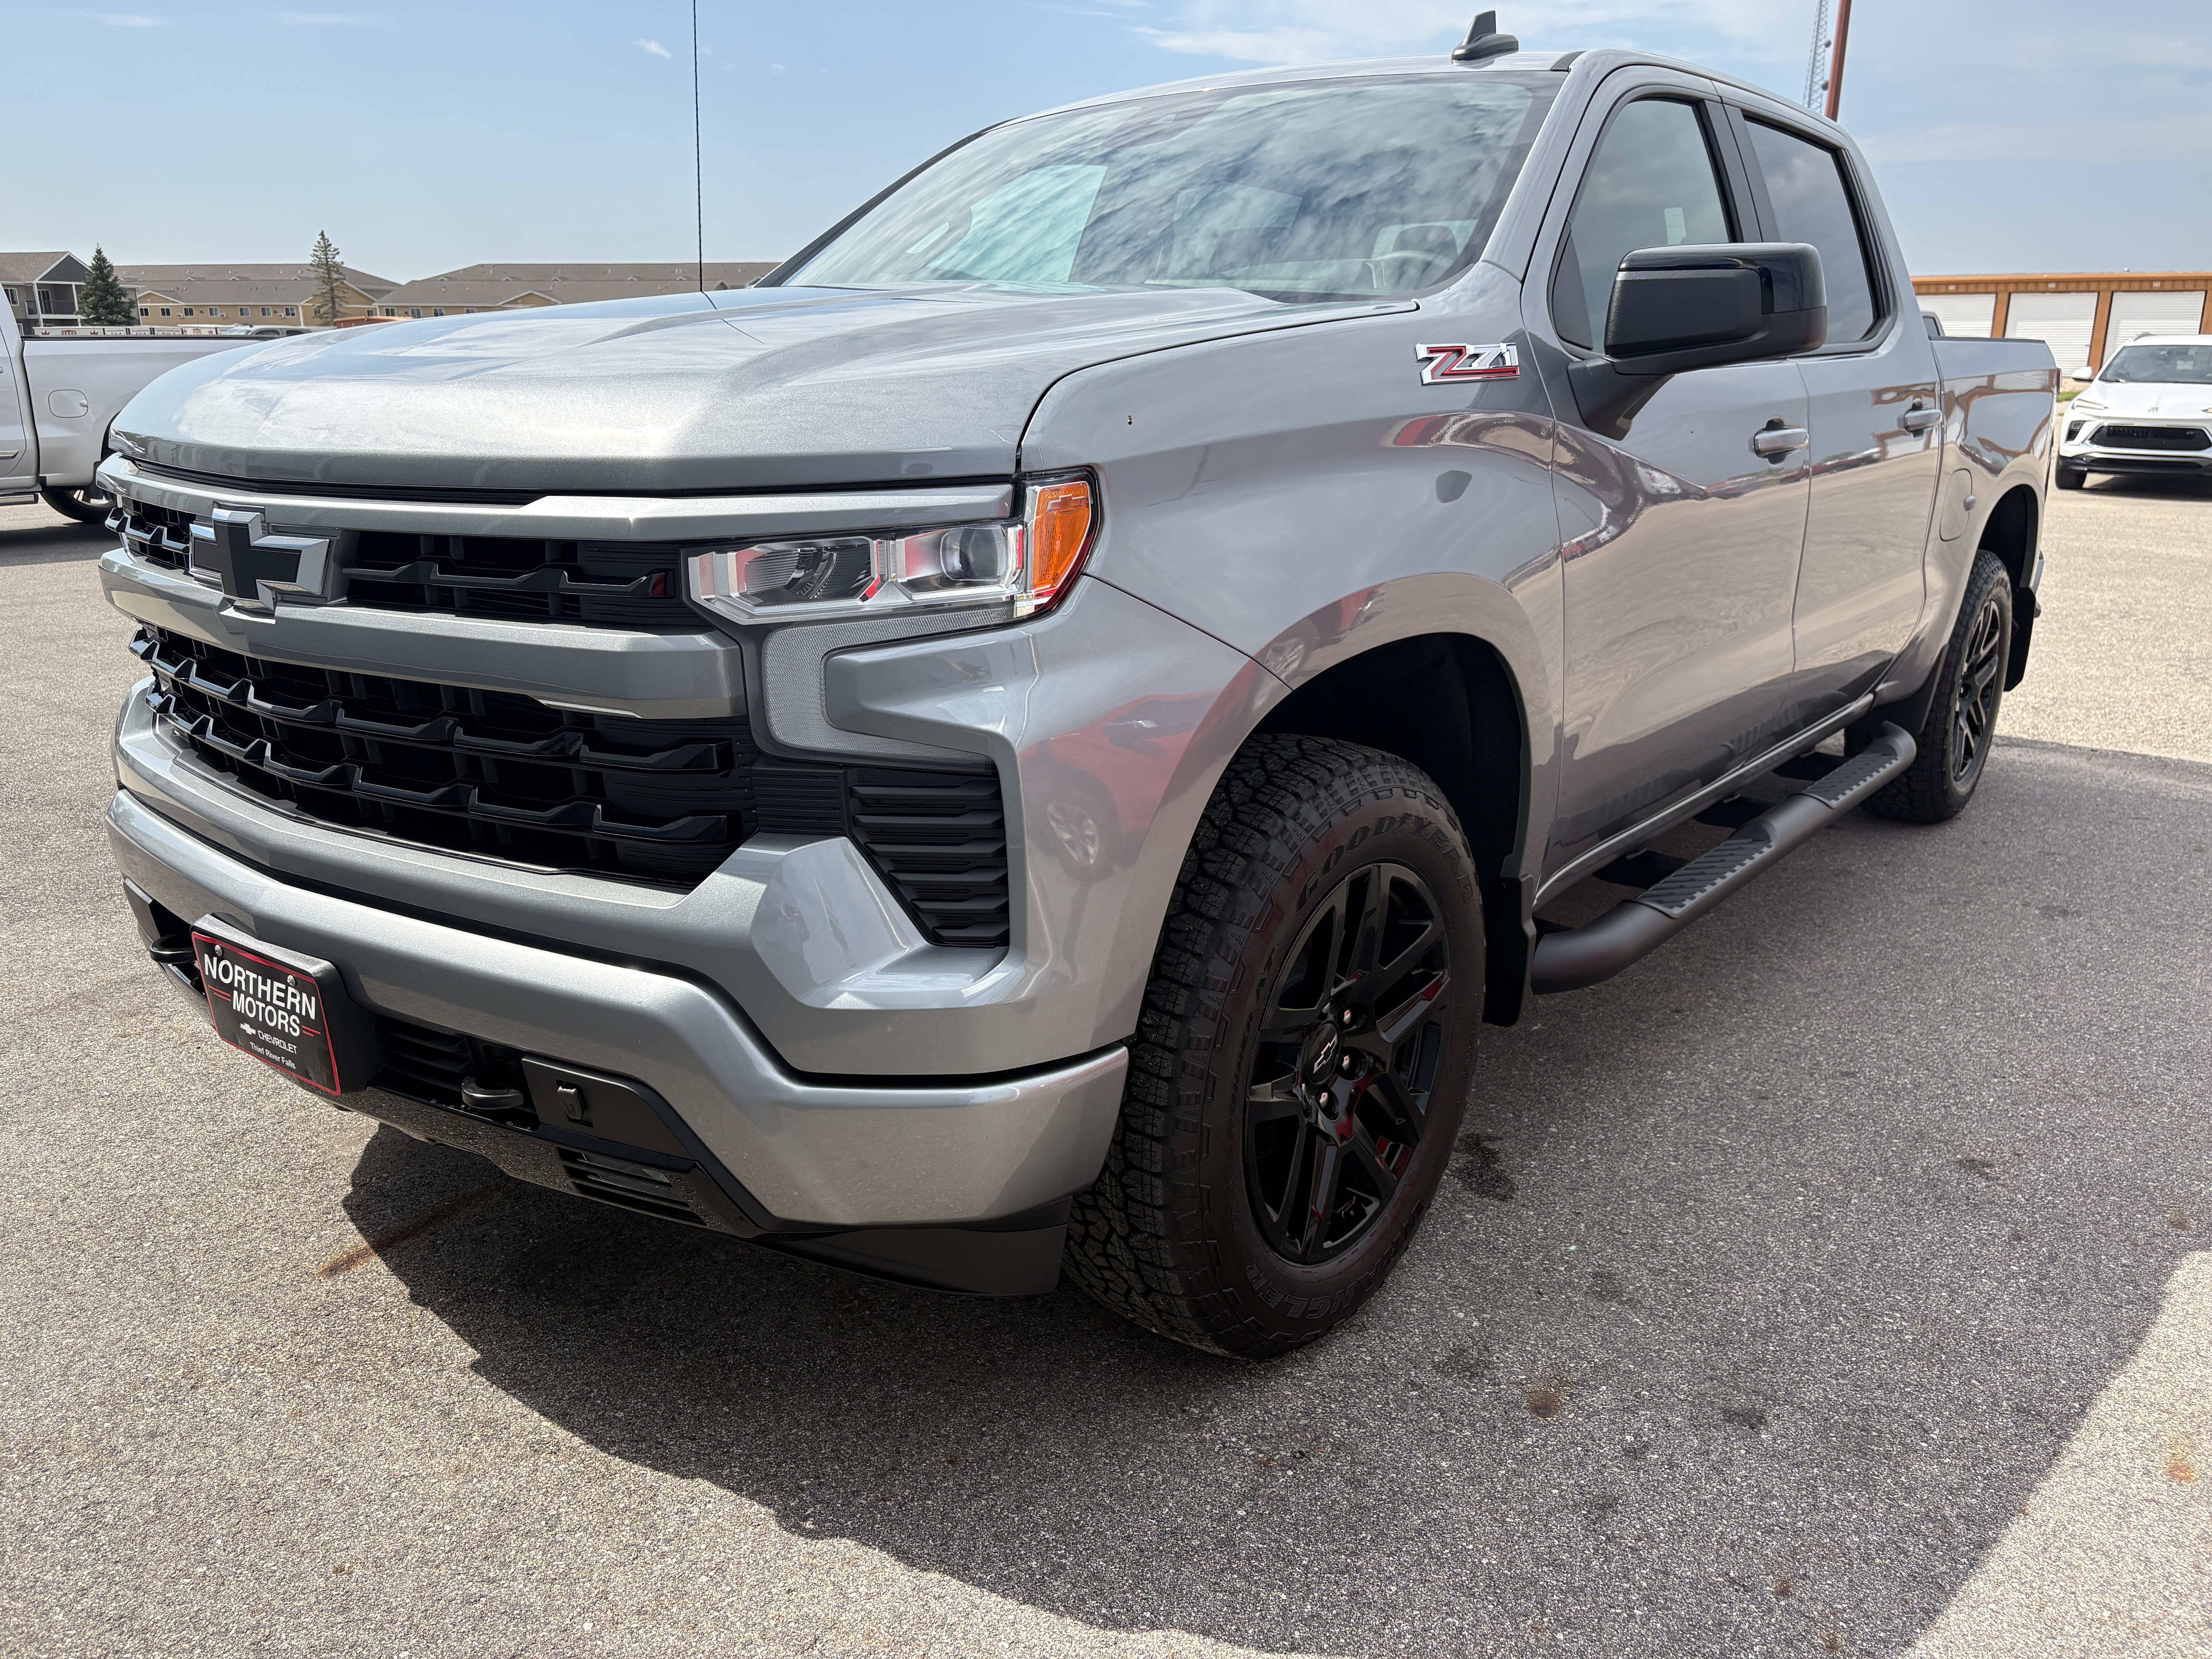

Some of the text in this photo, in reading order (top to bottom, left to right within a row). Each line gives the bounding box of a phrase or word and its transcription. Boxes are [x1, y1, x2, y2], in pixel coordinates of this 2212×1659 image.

[1415, 342, 1520, 385] Z71
[1296, 812, 1475, 915] GOODYEAR
[204, 953, 316, 1020] NORTHERN
[232, 990, 301, 1037] MOTORS
[249, 1041, 296, 1069] Thief River Falls
[258, 1030, 297, 1054] CHEVROLET
[1245, 1200, 1425, 1319] WRANGLER
